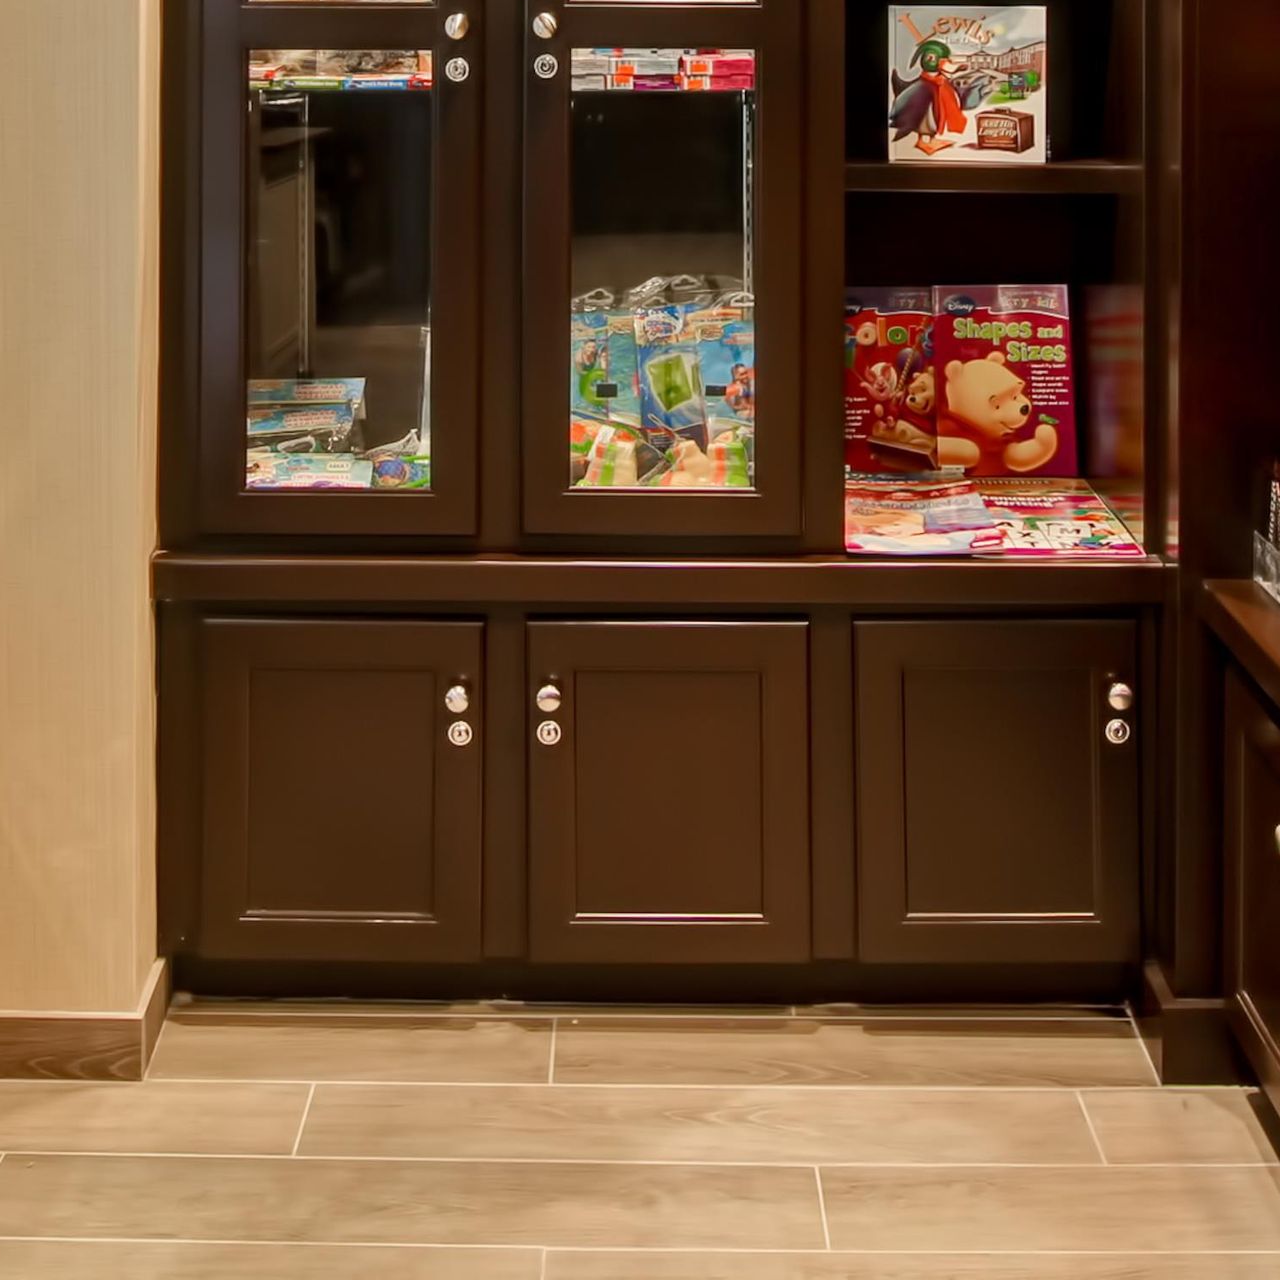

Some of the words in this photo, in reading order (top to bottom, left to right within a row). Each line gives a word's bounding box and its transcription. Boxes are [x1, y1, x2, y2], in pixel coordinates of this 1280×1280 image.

[953, 317, 1033, 346] Shapes
[1036, 324, 1064, 339] and
[1006, 340, 1067, 363] Sizes
